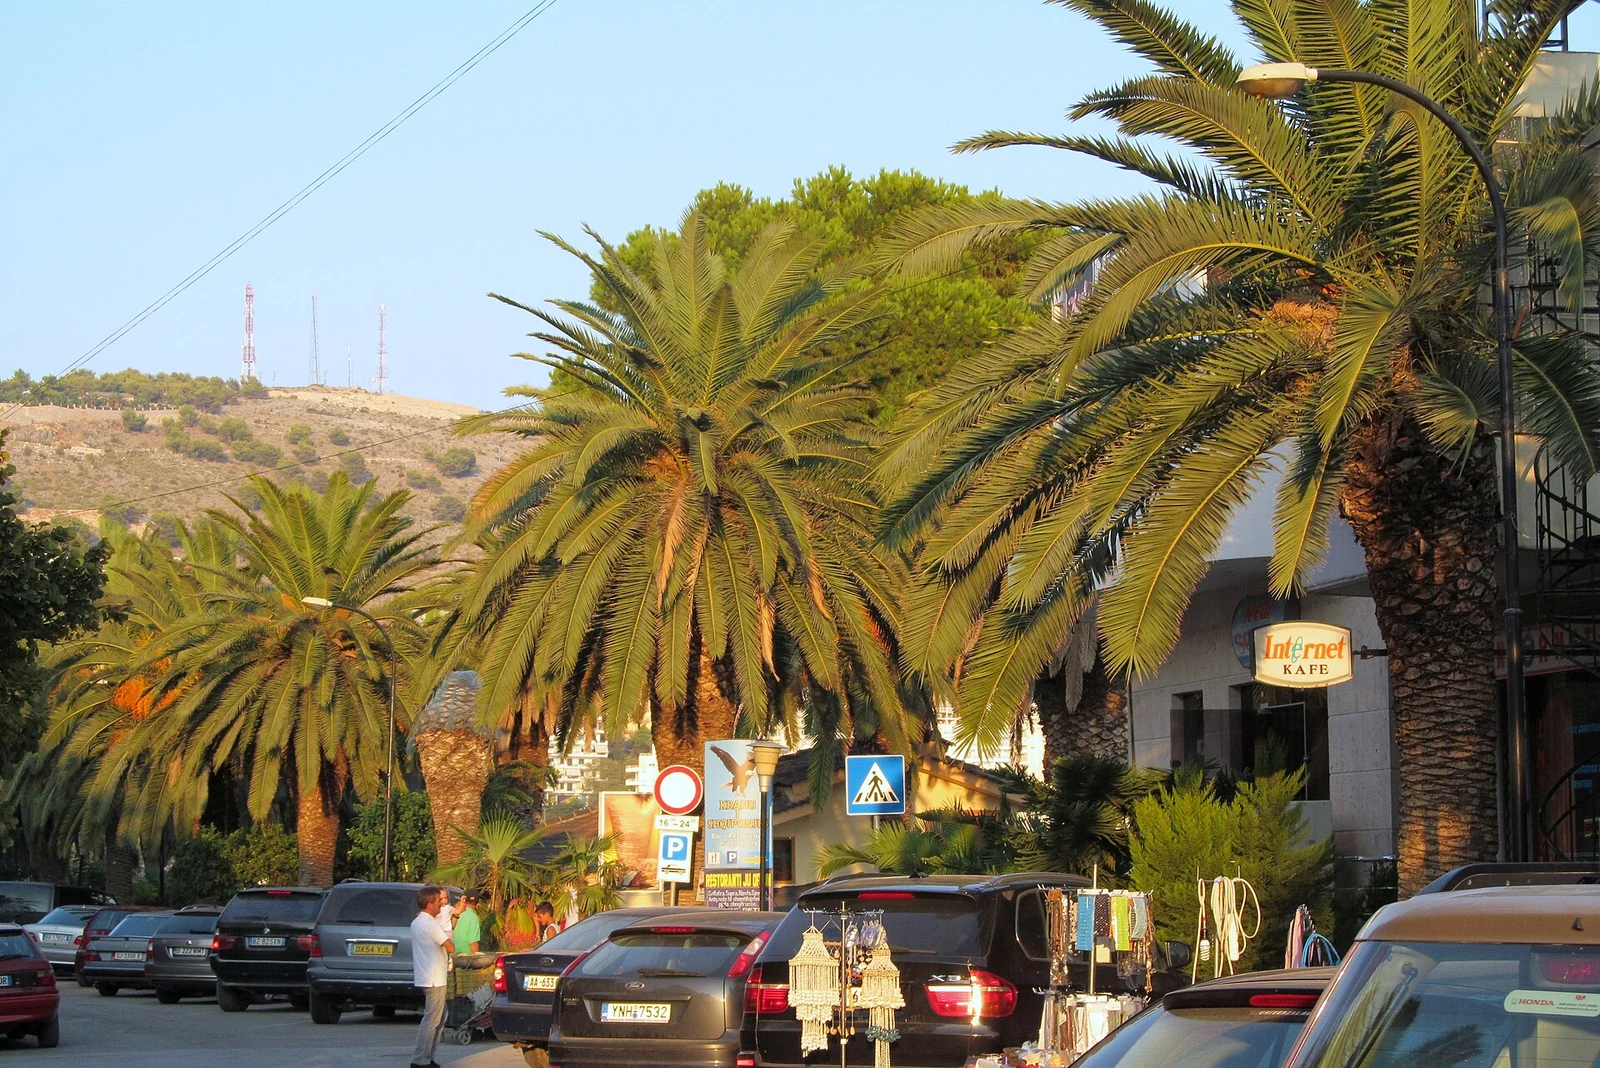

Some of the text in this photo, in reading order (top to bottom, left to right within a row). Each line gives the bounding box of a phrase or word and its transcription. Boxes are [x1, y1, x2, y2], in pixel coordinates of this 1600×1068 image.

[1263, 634, 1346, 663] Internet
[1283, 664, 1329, 675] KAFE
[667, 837, 684, 858] P
[355, 945, 391, 954] DX54 YJL
[529, 977, 557, 988] AA-633
[1518, 998, 1554, 1006] HONDA
